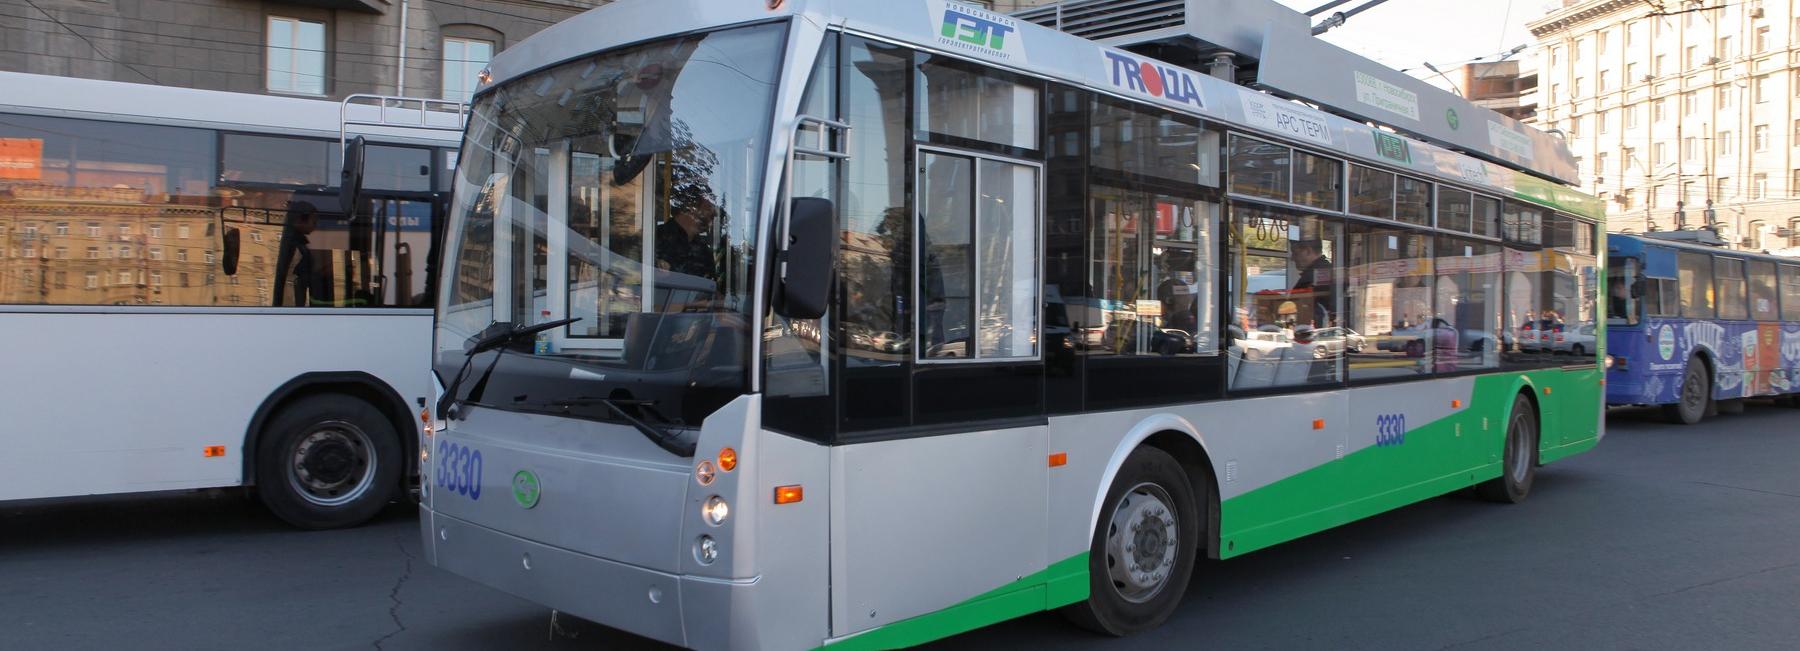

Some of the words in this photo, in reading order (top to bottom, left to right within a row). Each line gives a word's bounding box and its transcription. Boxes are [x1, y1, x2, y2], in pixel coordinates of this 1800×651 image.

[946, 2, 1015, 27] НОВОСИБИРСК
[1276, 112, 1299, 134] АРС
[1300, 118, 1330, 142] ТЕРМ
[1376, 414, 1405, 447] 3330
[437, 440, 482, 501] 3330
